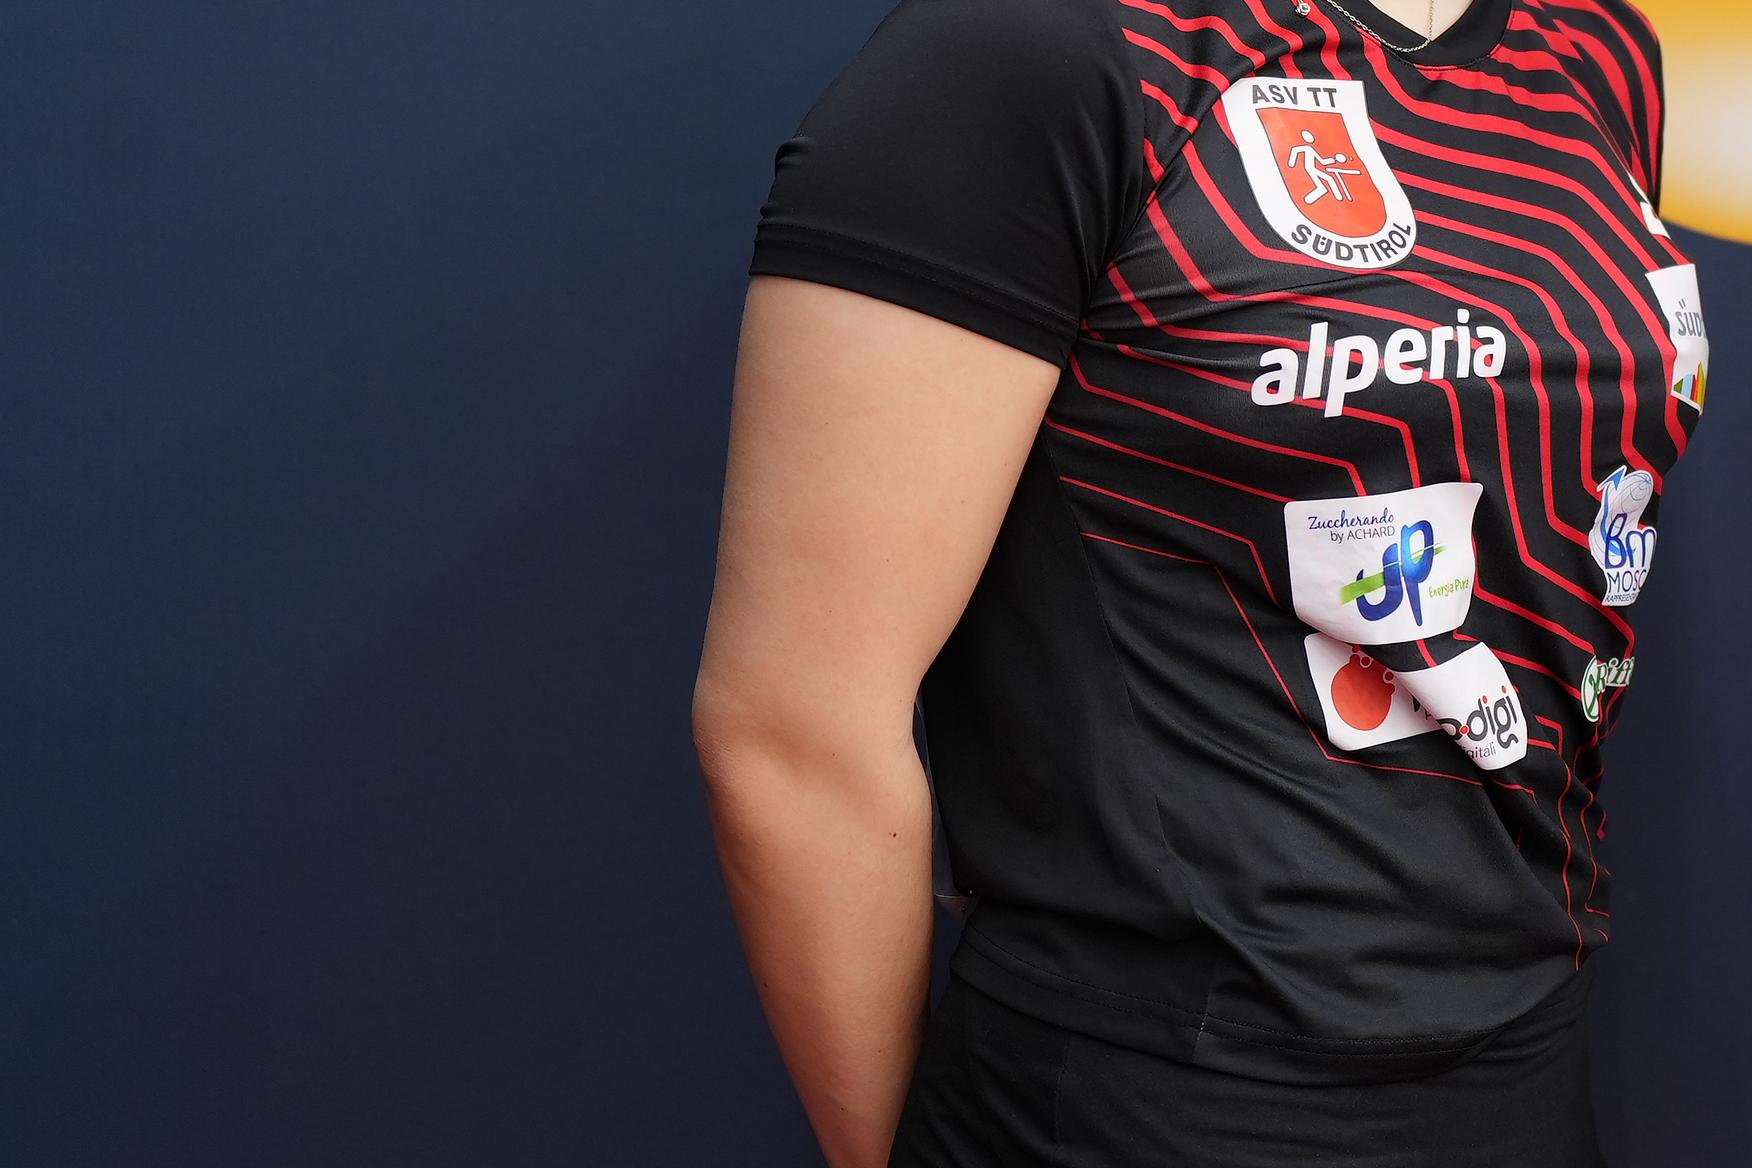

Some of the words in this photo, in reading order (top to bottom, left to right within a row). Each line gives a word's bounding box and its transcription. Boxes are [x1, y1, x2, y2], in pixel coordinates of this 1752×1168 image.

[1252, 84, 1298, 105] ASV
[1306, 87, 1337, 108] TT
[1290, 222, 1412, 263] SÜDTIROL
[1251, 308, 1507, 418] alperia
[1308, 507, 1395, 530] Zuccherando
[1330, 530, 1344, 544] by
[1347, 525, 1396, 541] ACHARD
